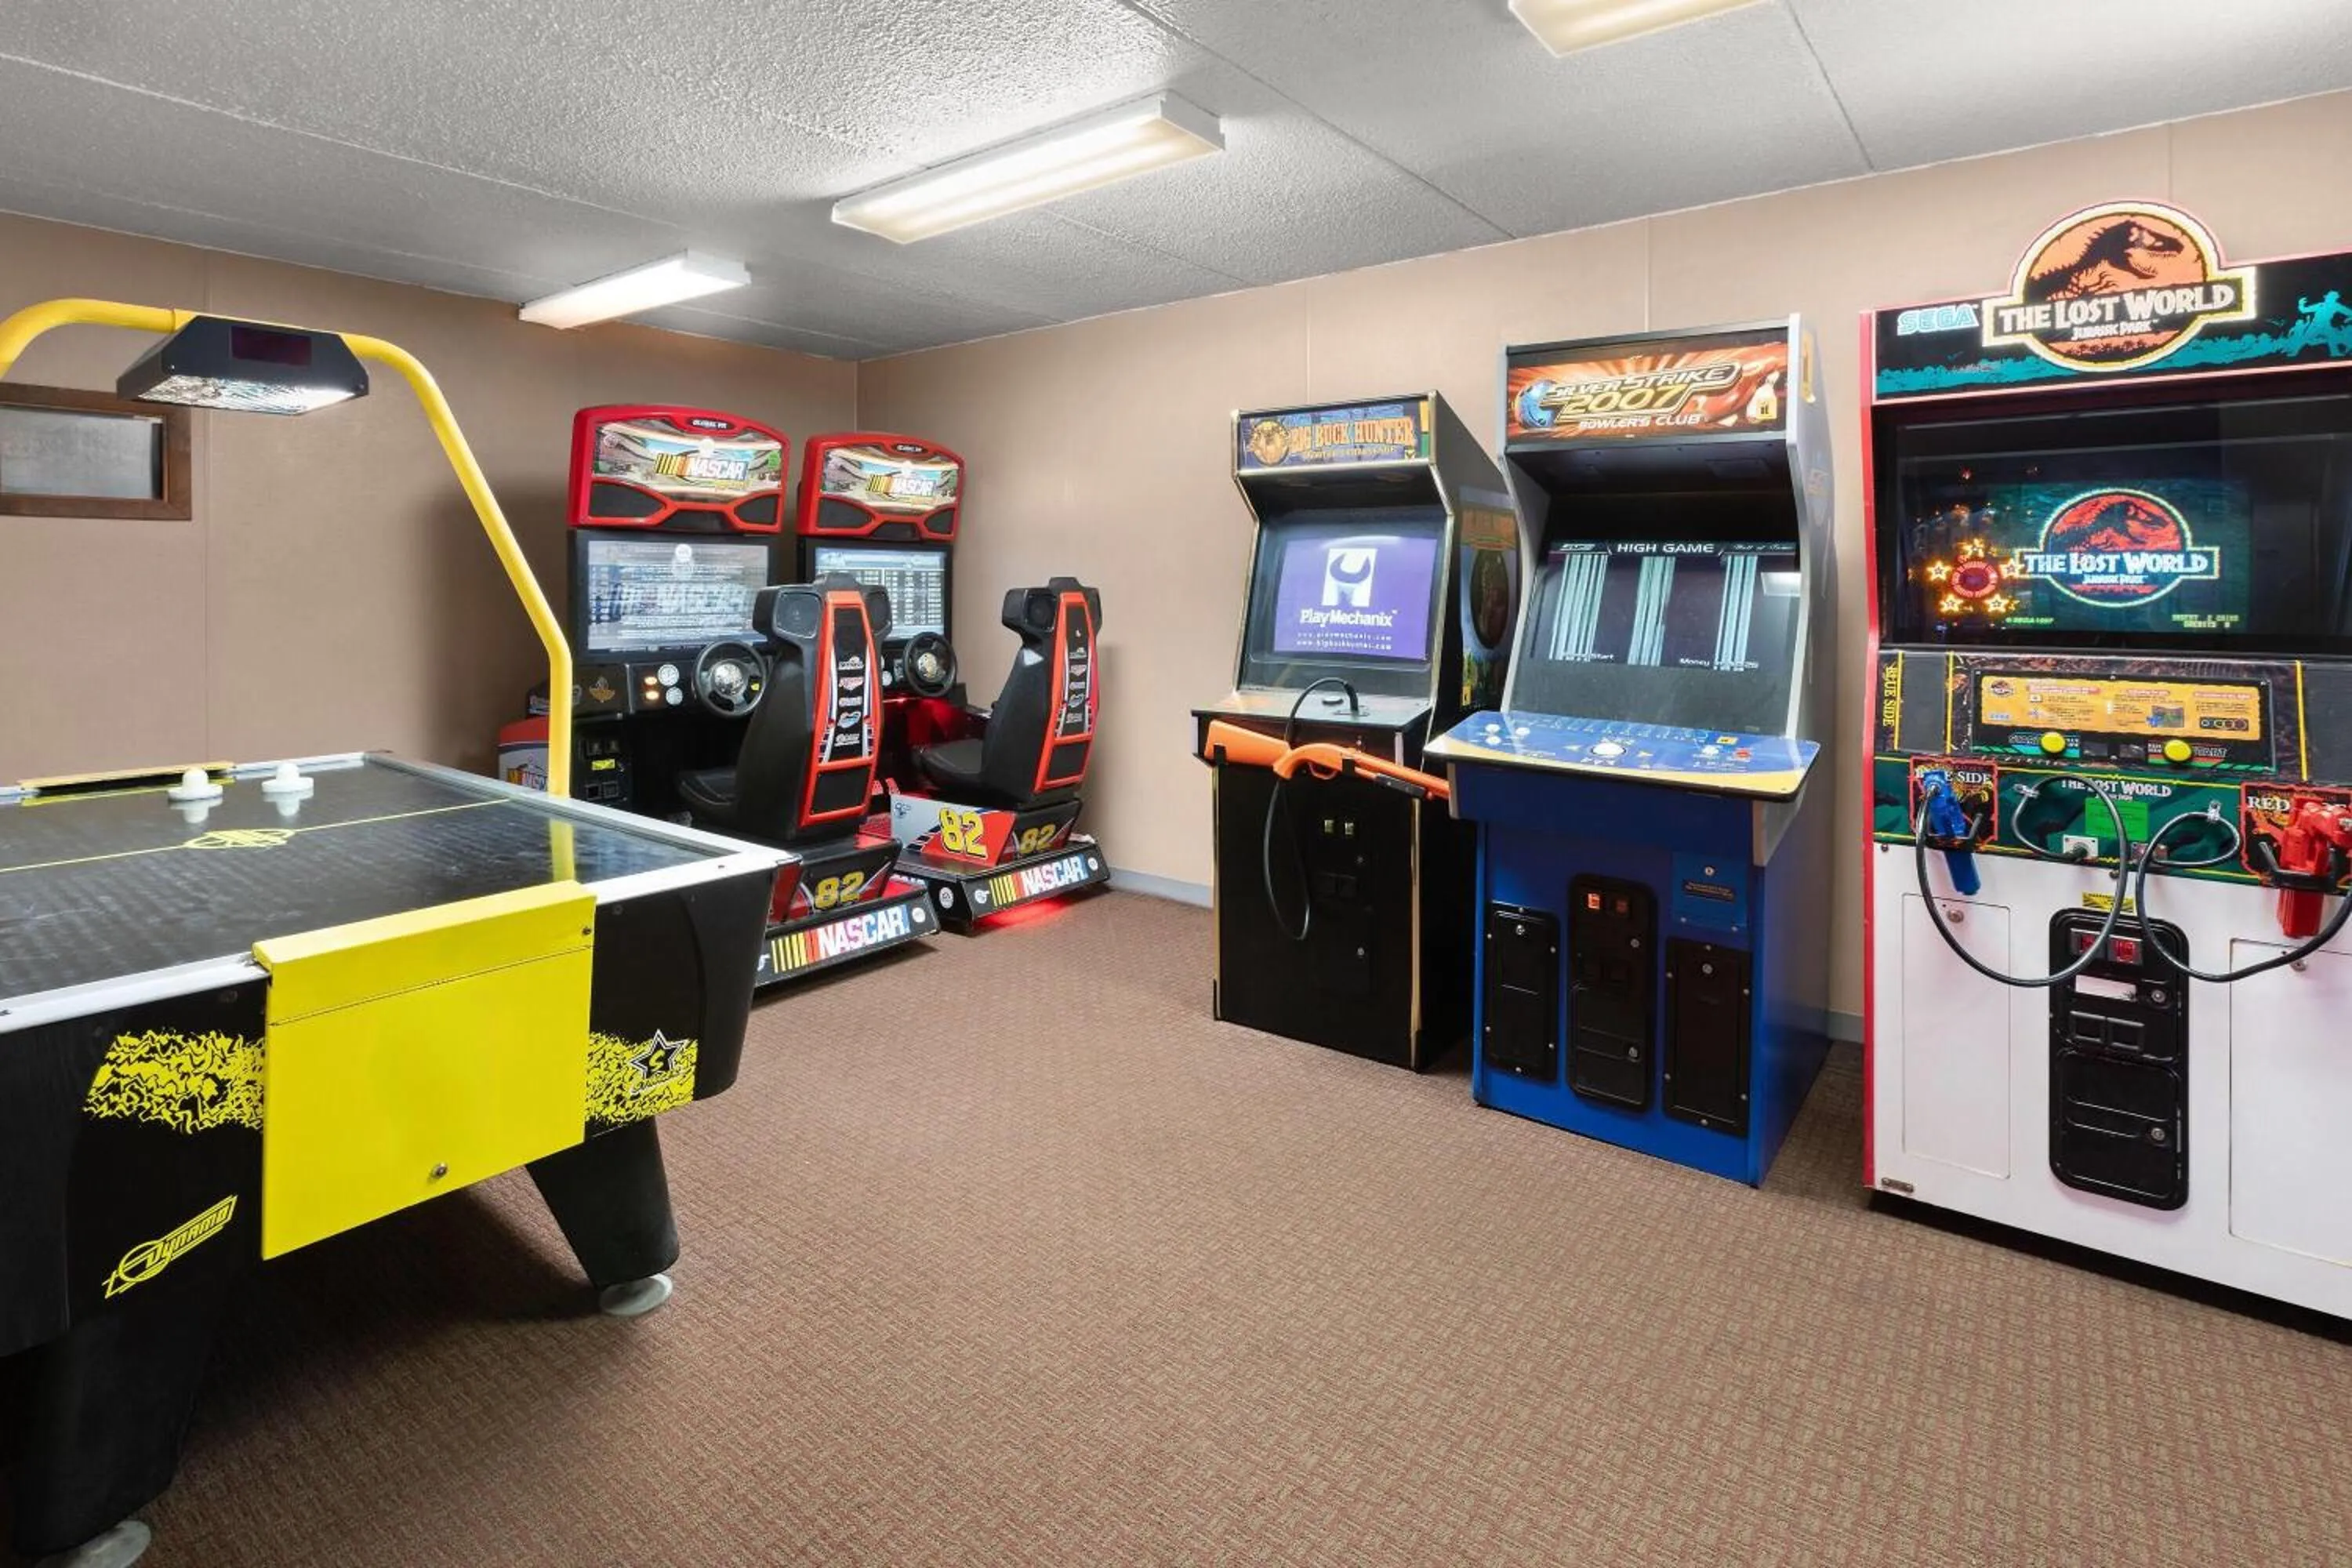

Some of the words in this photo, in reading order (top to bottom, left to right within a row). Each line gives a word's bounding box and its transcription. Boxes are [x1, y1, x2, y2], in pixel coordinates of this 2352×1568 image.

[1897, 304, 1979, 336] SEGA
[1999, 304, 2051, 332] THE
[2055, 295, 2119, 329] LOST
[2125, 285, 2234, 321] WORLD
[2071, 323, 2118, 341] JURASSIC
[2119, 321, 2153, 336] PARK
[1553, 379, 1620, 398] SILVER
[1623, 365, 1725, 389] STRIKE
[1563, 385, 1687, 414] 2007
[1288, 426, 1312, 452] BIG
[1316, 423, 1349, 448] BUCK
[1354, 416, 1417, 446] HUNTER
[1579, 416, 1650, 429] BOWLER'S
[1655, 414, 1701, 426] CLUB
[687, 456, 746, 481] NASCAR
[891, 477, 934, 496] NASCAR
[1617, 543, 1657, 553] HIGH
[1663, 543, 1715, 554] GAME
[2024, 554, 2067, 573] THE
[2070, 552, 2120, 574] LOST
[2122, 552, 2209, 574] WORLD
[1300, 608, 1392, 627] PlayMechanix
[1884, 664, 1898, 697] BLUE
[1883, 699, 1895, 727] SIDE
[1957, 771, 1991, 784] SIDE
[2120, 781, 2172, 797] WORLD
[2247, 796, 2291, 812] RED
[939, 808, 988, 858] 82
[1019, 823, 1056, 854] 82
[815, 871, 865, 909] 82
[1022, 855, 1086, 897] NASCAR
[818, 905, 905, 960] NASCAR
